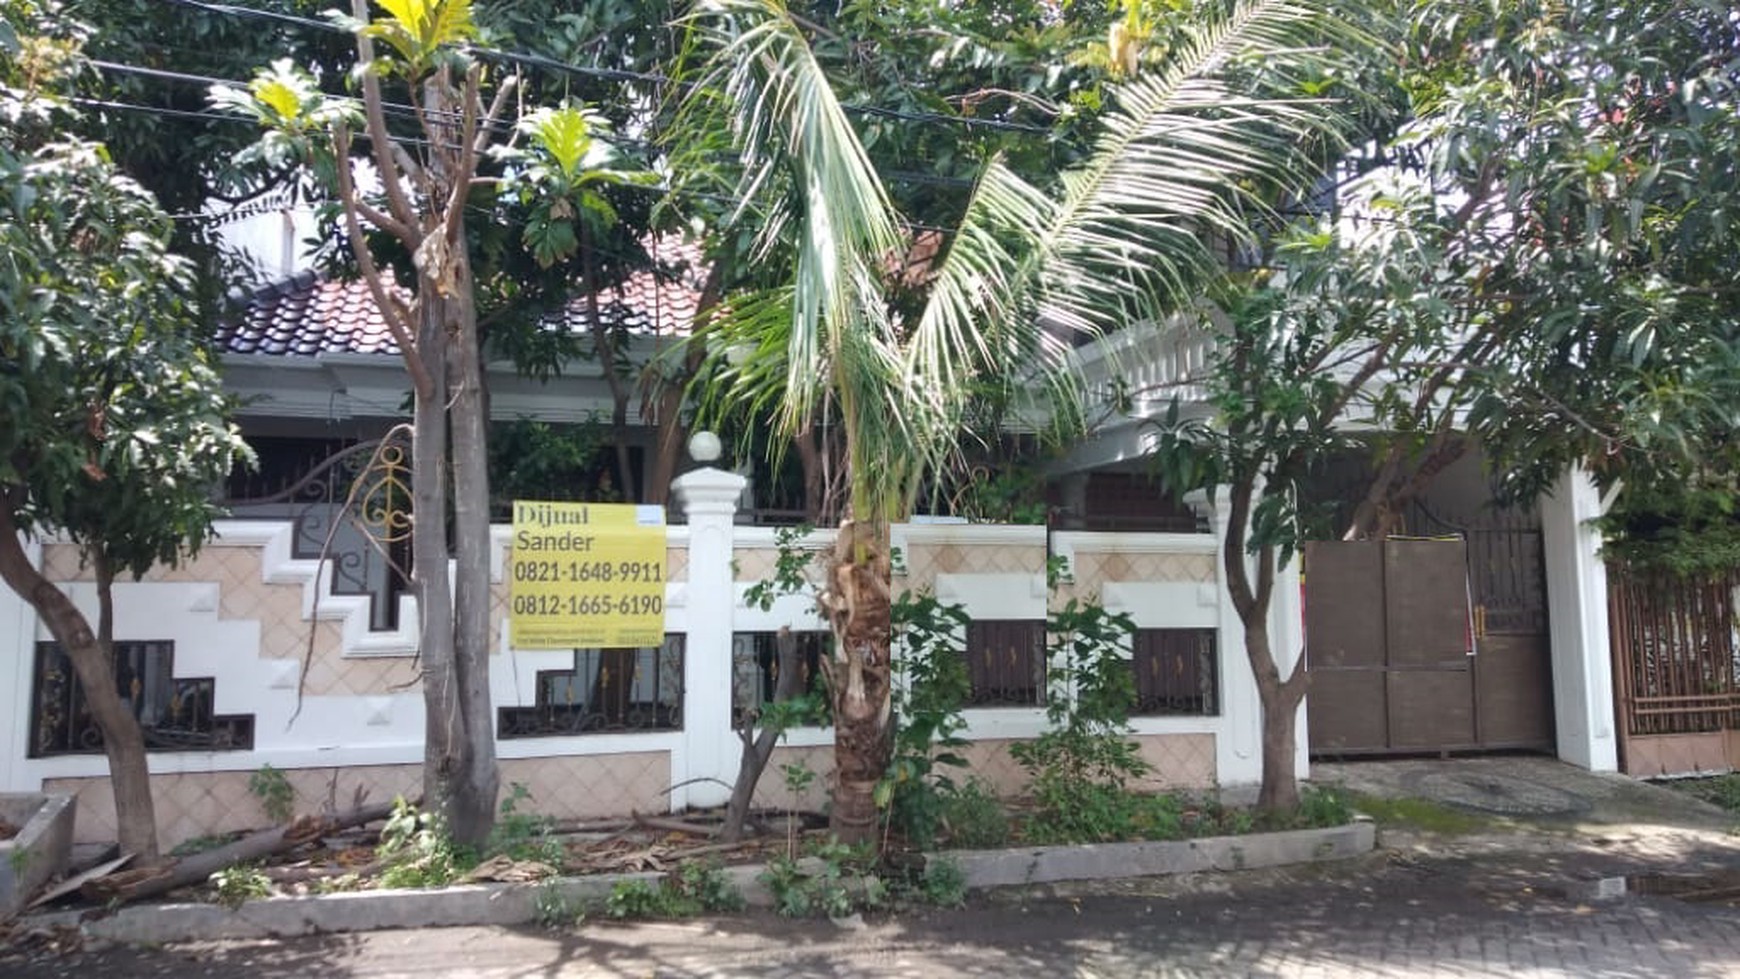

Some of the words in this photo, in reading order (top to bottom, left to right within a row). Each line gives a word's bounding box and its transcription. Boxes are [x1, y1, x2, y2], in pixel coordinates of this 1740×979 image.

[518, 505, 588, 528] Dijual
[517, 530, 595, 551] Sander
[515, 561, 661, 582] 0821-1648-9911
[514, 595, 662, 615] 0812-1665-6190
